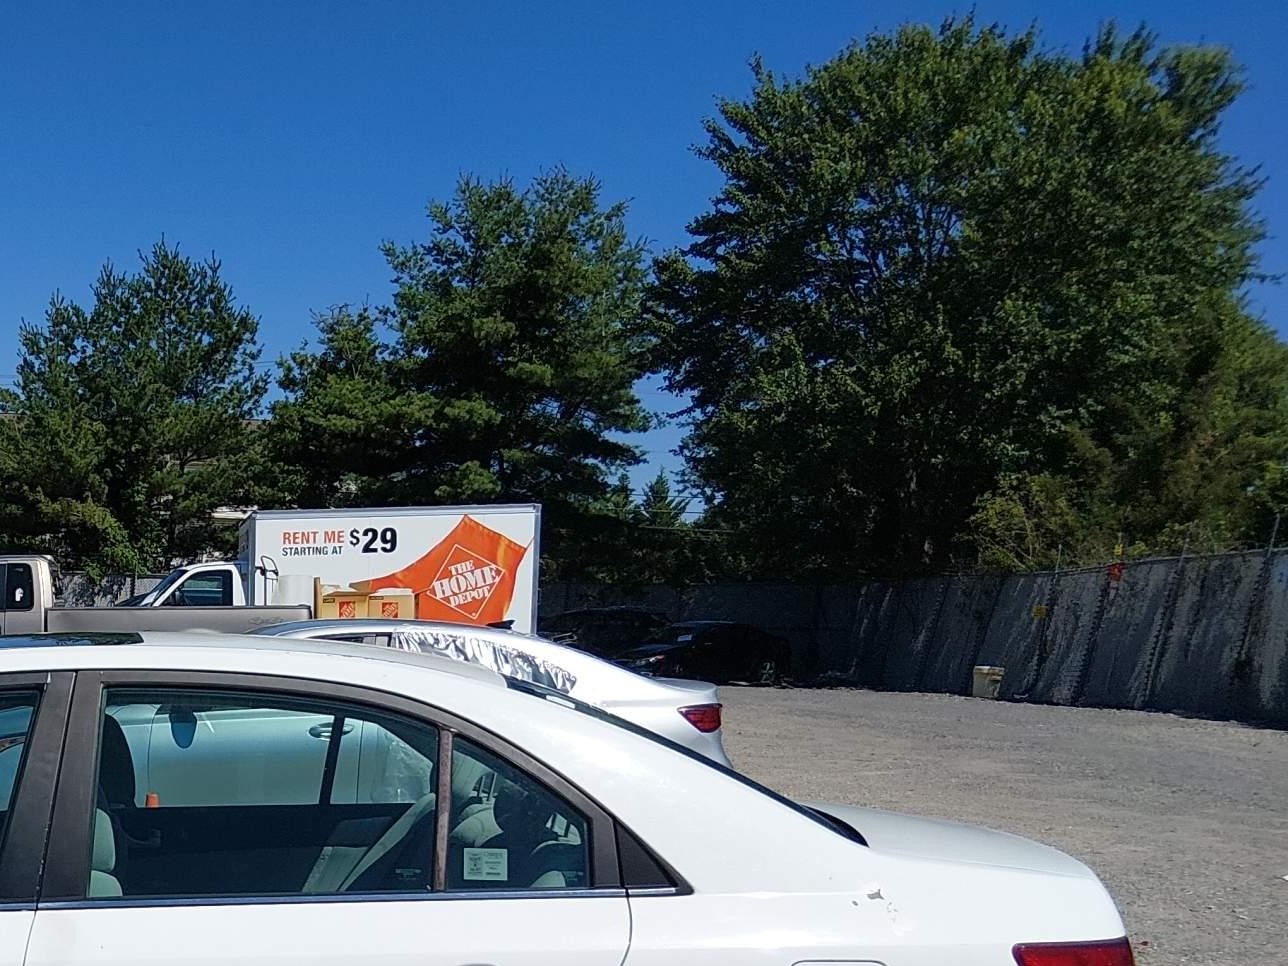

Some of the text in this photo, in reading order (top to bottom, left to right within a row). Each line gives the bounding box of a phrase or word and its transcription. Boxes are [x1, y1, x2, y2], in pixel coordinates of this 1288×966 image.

[282, 527, 398, 554] RENT ME $29
[282, 545, 344, 557] STARTING AT
[448, 559, 475, 576] THE
[433, 564, 500, 600] HOME
[449, 586, 491, 607] DEPOT
